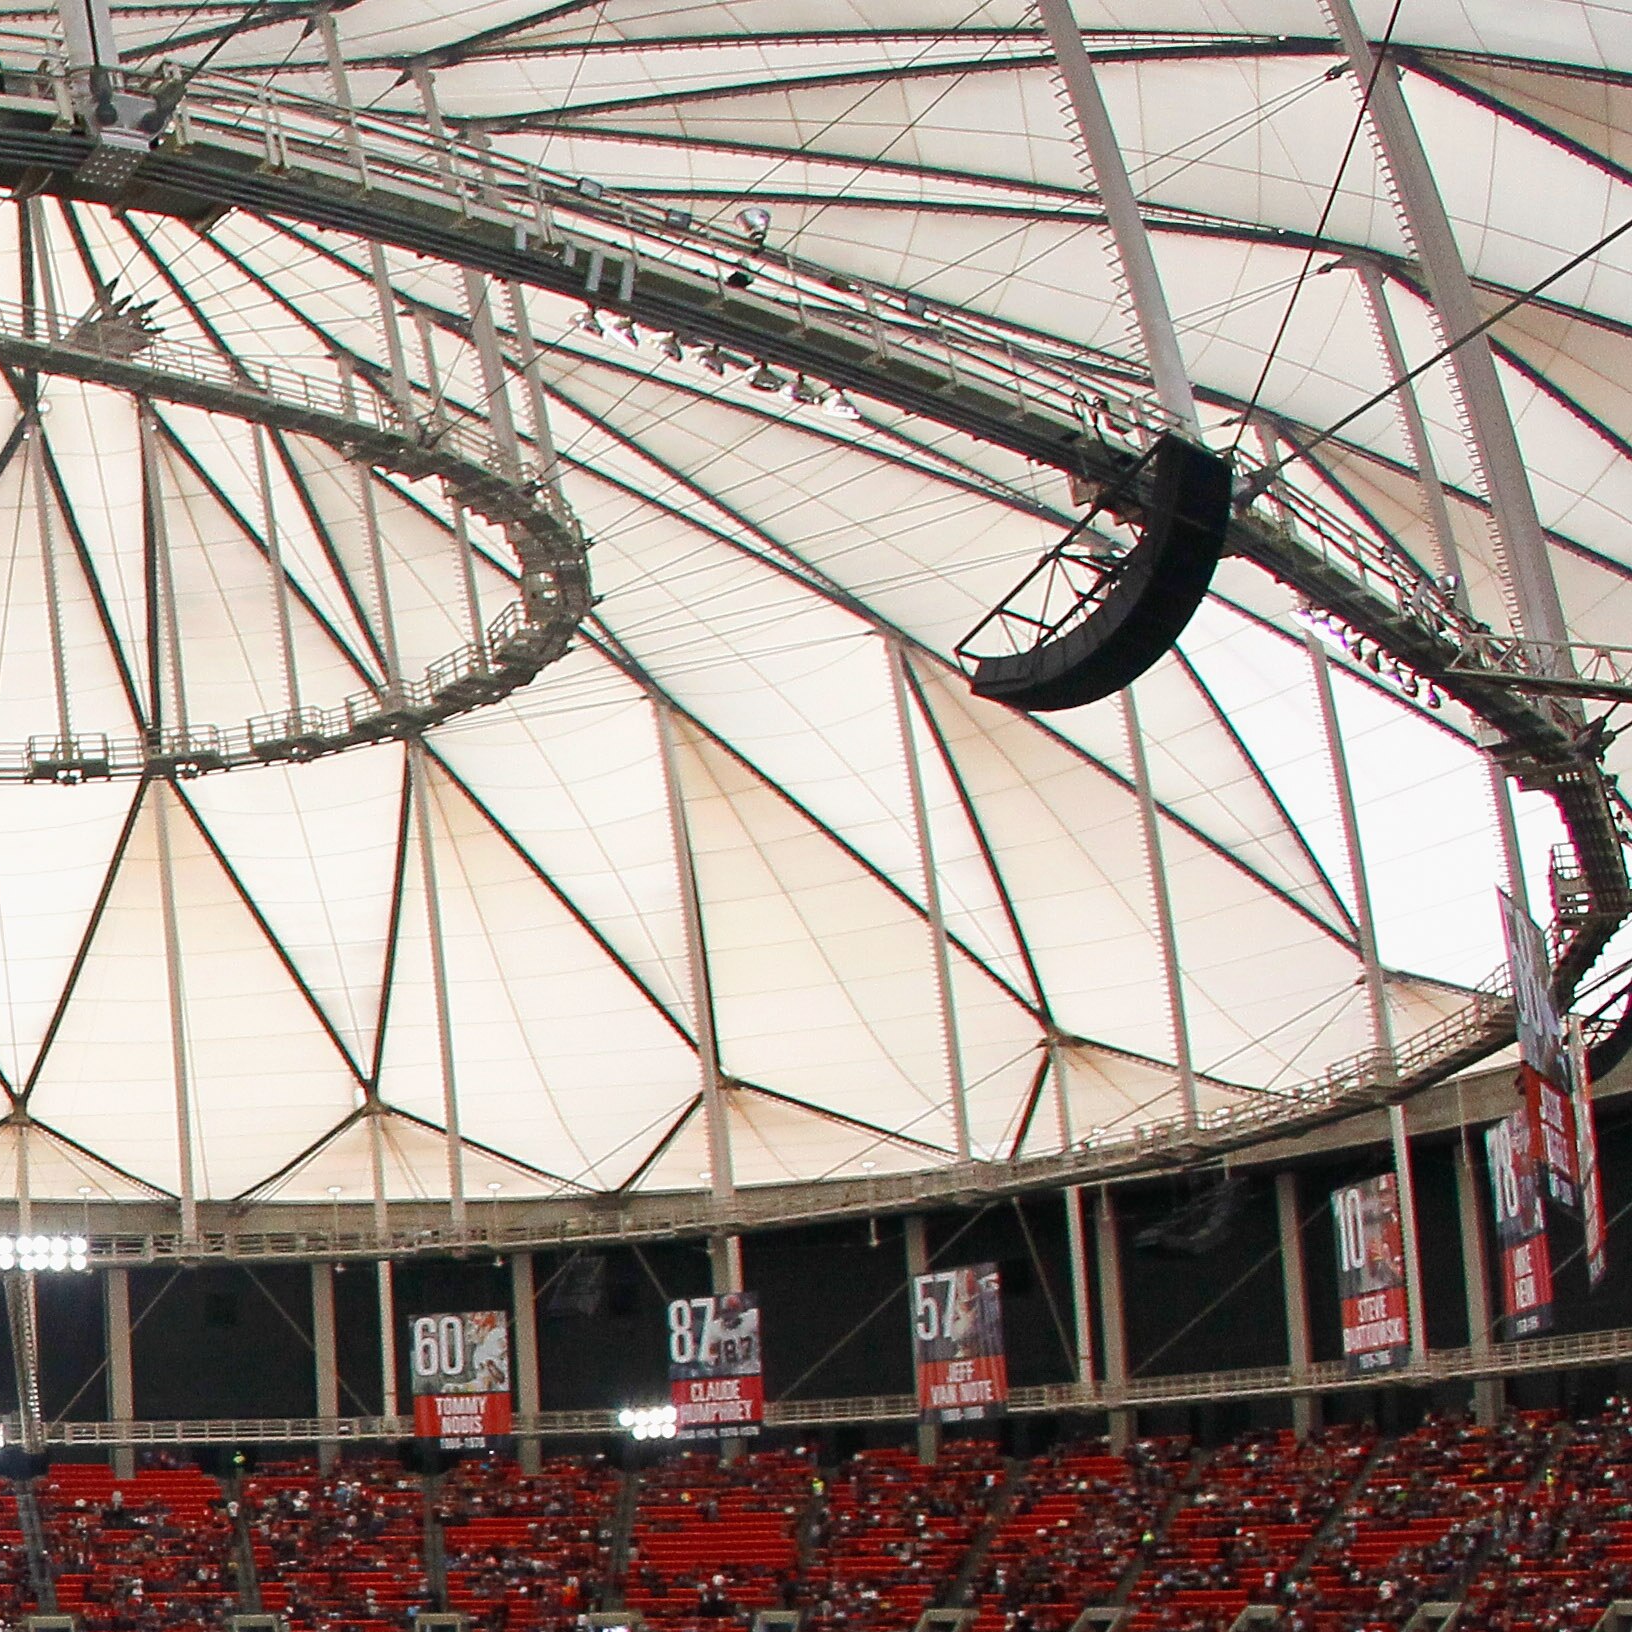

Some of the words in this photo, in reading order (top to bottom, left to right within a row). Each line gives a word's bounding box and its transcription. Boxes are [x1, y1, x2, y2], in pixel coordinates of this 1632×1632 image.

[1331, 1188, 1365, 1272] 10
[668, 1298, 715, 1363] 87
[914, 1270, 957, 1341] 57
[414, 1316, 464, 1376] 60
[434, 1397, 487, 1416] TOMMY
[690, 1380, 741, 1402] CLAUDE
[441, 1416, 483, 1434] NOBIS
